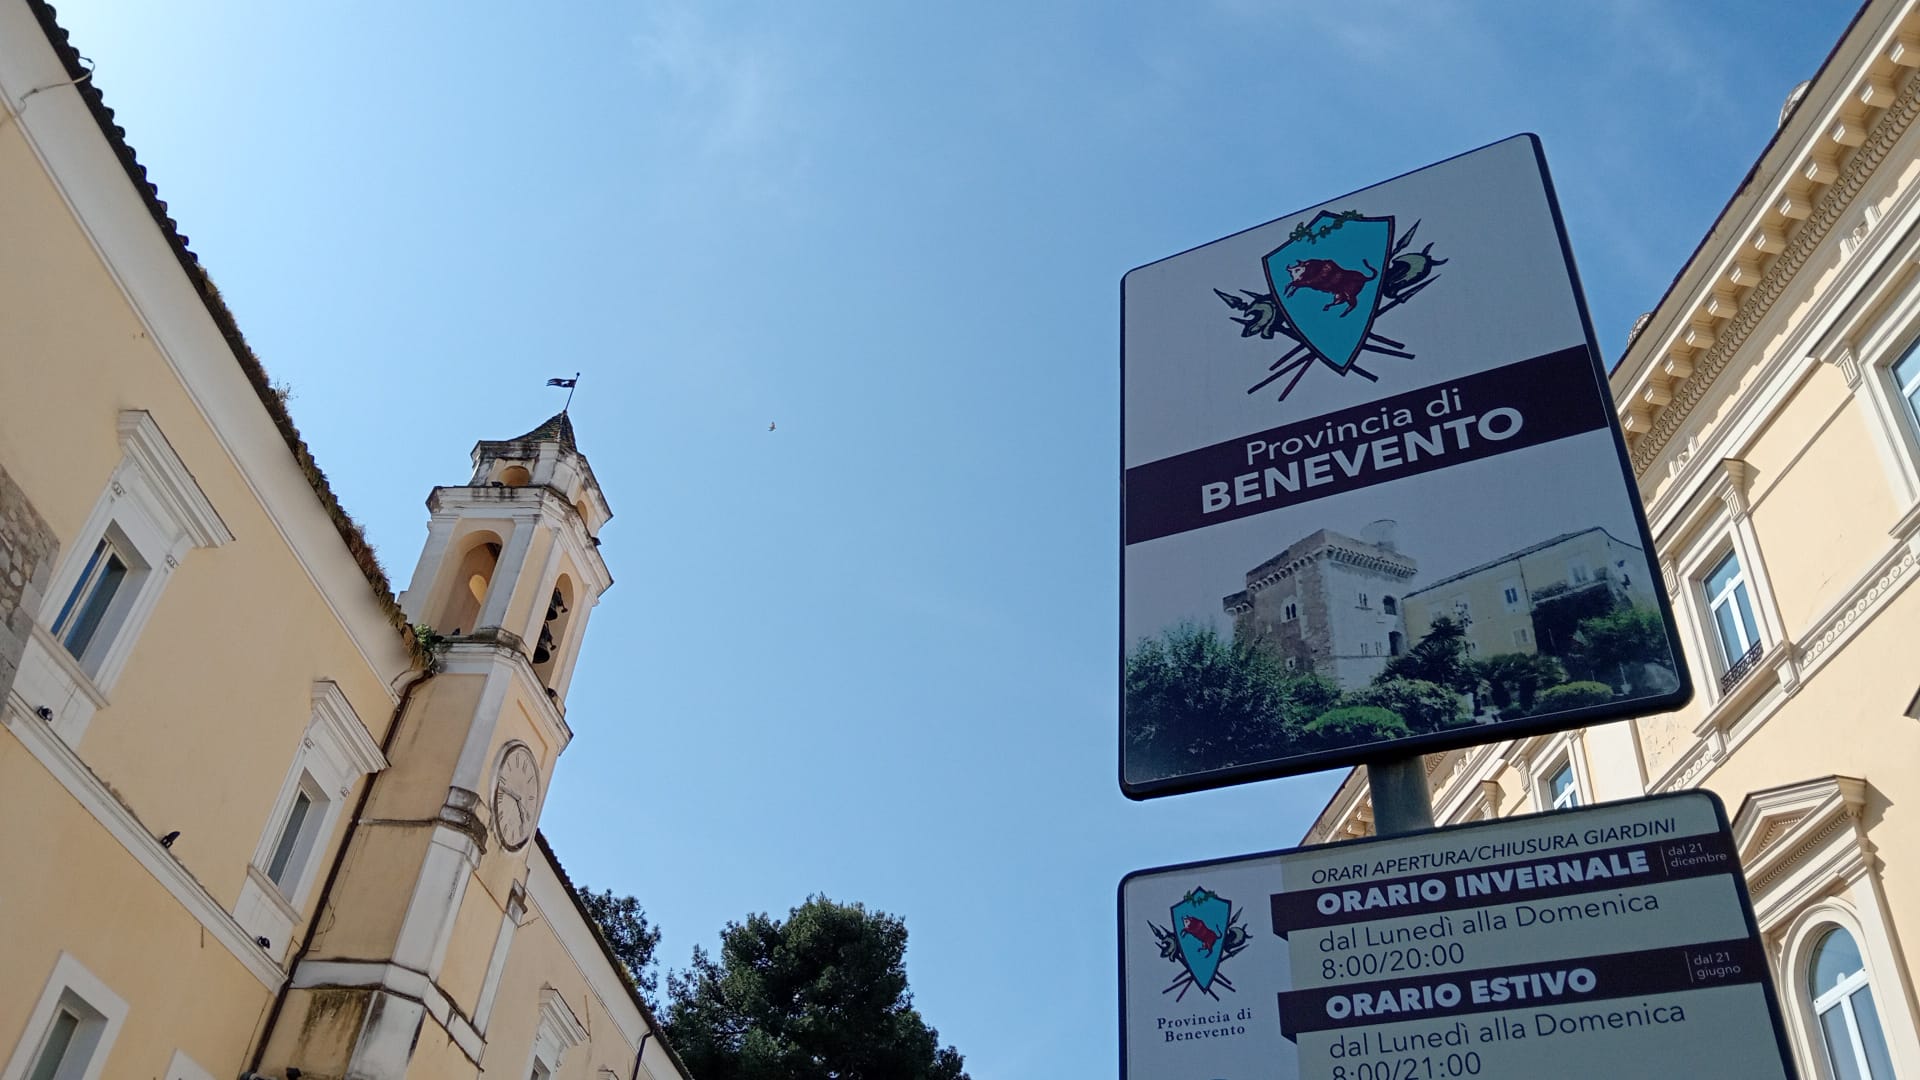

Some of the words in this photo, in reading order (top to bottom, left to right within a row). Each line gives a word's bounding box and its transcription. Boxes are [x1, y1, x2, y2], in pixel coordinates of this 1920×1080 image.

[1247, 407, 1413, 466] Provincia
[1426, 387, 1462, 418] di
[1201, 406, 1524, 514] BENEVENTO
[1311, 863, 1368, 884] ORARI
[1372, 832, 1579, 876] APERTURA/CHIUSURA
[1584, 818, 1676, 845] GIARDINI
[1668, 844, 1686, 857] dal
[1688, 842, 1703, 854] 21
[1670, 852, 1727, 868] dicembre
[1316, 879, 1447, 916] ORARIO
[1455, 850, 1650, 898] INVERNALE
[1319, 927, 1357, 953] dal
[1366, 915, 1453, 947] Lunedì
[1462, 909, 1507, 935] alla
[1516, 893, 1660, 928] Domenica
[1322, 942, 1465, 980] 8:00/20:00
[1694, 953, 1713, 966] dal
[1715, 951, 1730, 963] 21
[1696, 963, 1741, 980] giugno
[1326, 982, 1462, 1020] ORARIO
[1470, 967, 1597, 1005] ESTIVO
[1157, 1012, 1231, 1030] Provincia
[1234, 1008, 1252, 1022] di
[1164, 1025, 1245, 1042] Benevento
[1329, 1033, 1369, 1059] dal
[1379, 1023, 1469, 1054] Lunedì
[1479, 1014, 1527, 1043] alla
[1535, 1002, 1686, 1036] Domenica
[1332, 1051, 1481, 1080] 8:00/21:00
